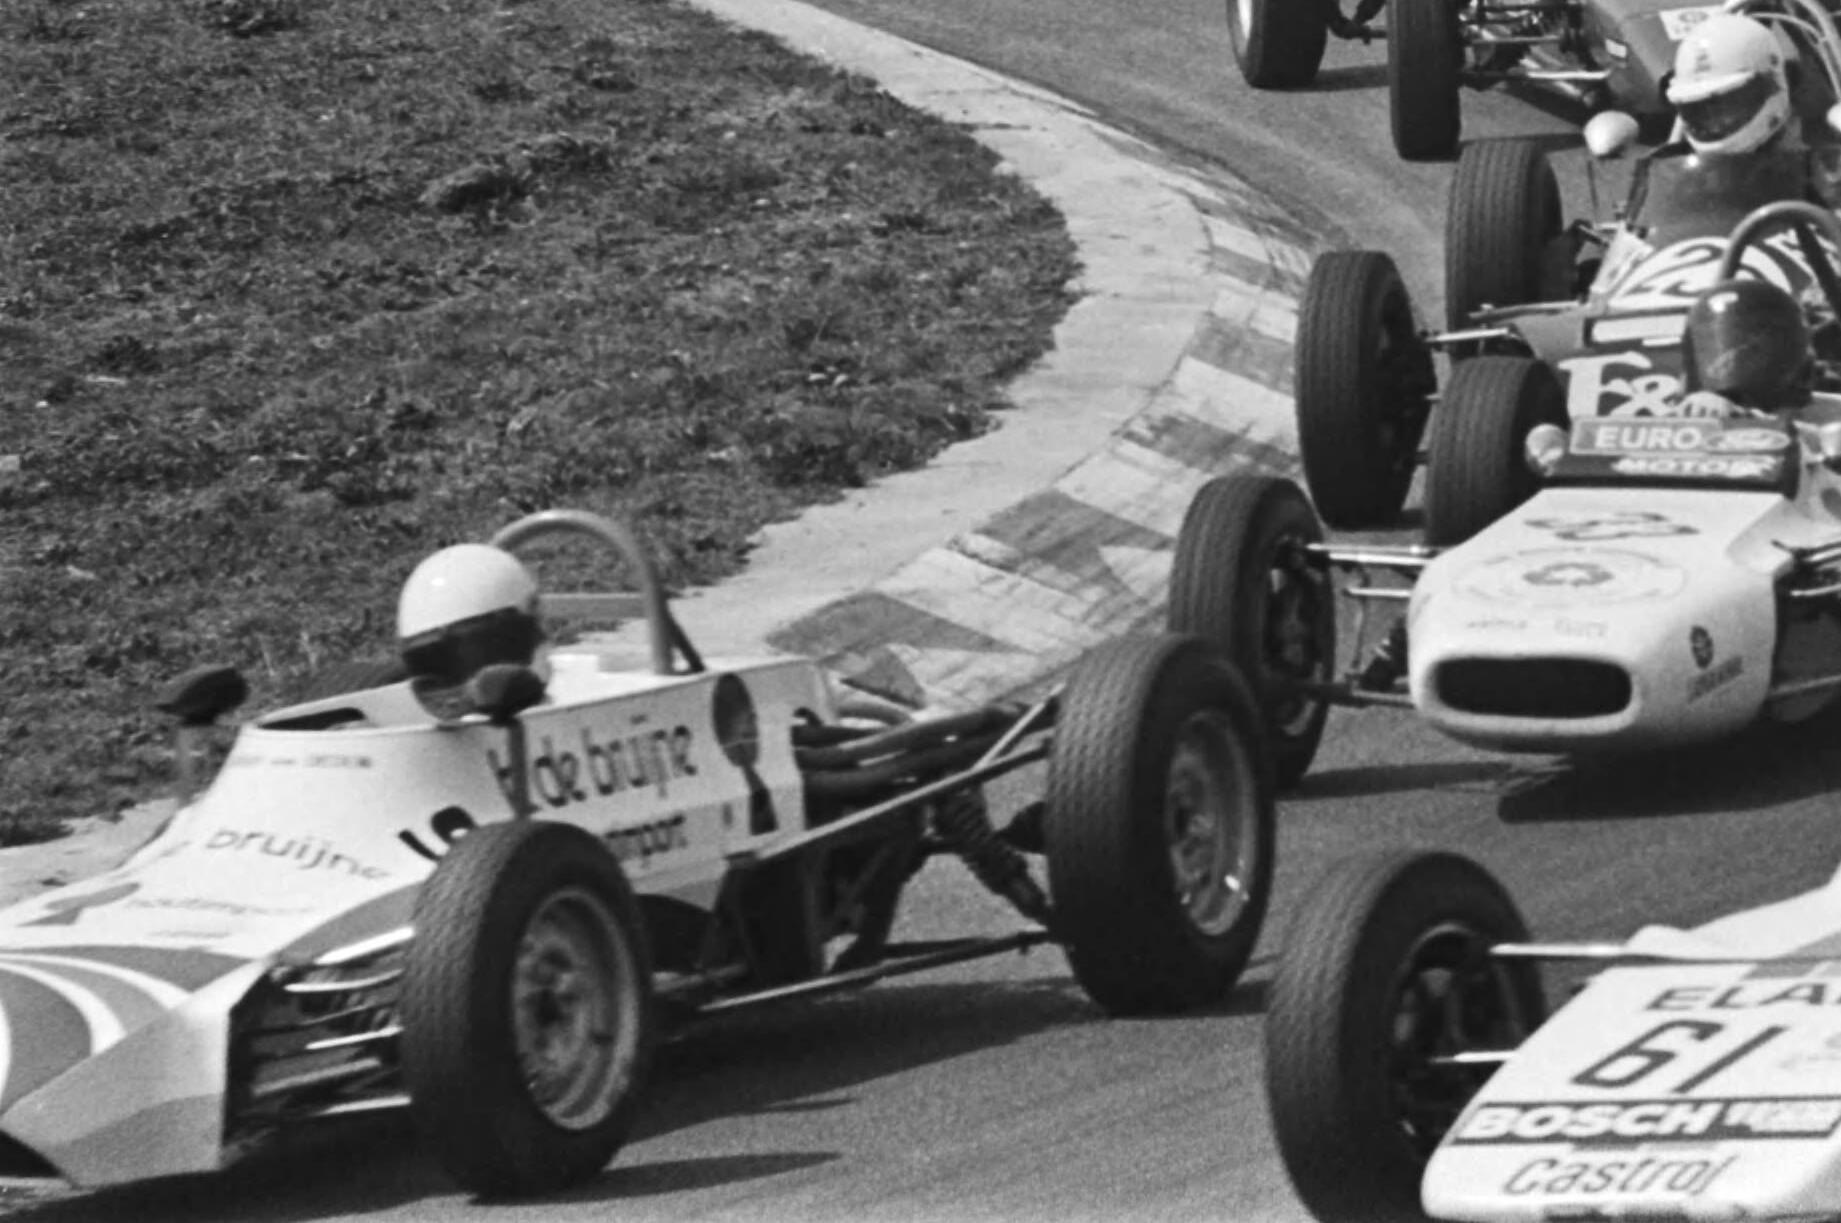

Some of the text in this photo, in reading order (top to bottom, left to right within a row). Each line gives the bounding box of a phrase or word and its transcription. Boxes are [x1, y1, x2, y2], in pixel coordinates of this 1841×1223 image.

[1595, 425, 1703, 450] EURO
[1572, 1019, 1790, 1095] 61
[1460, 1102, 1727, 1139] BOSCH
[1502, 1152, 1742, 1197] Castrol
